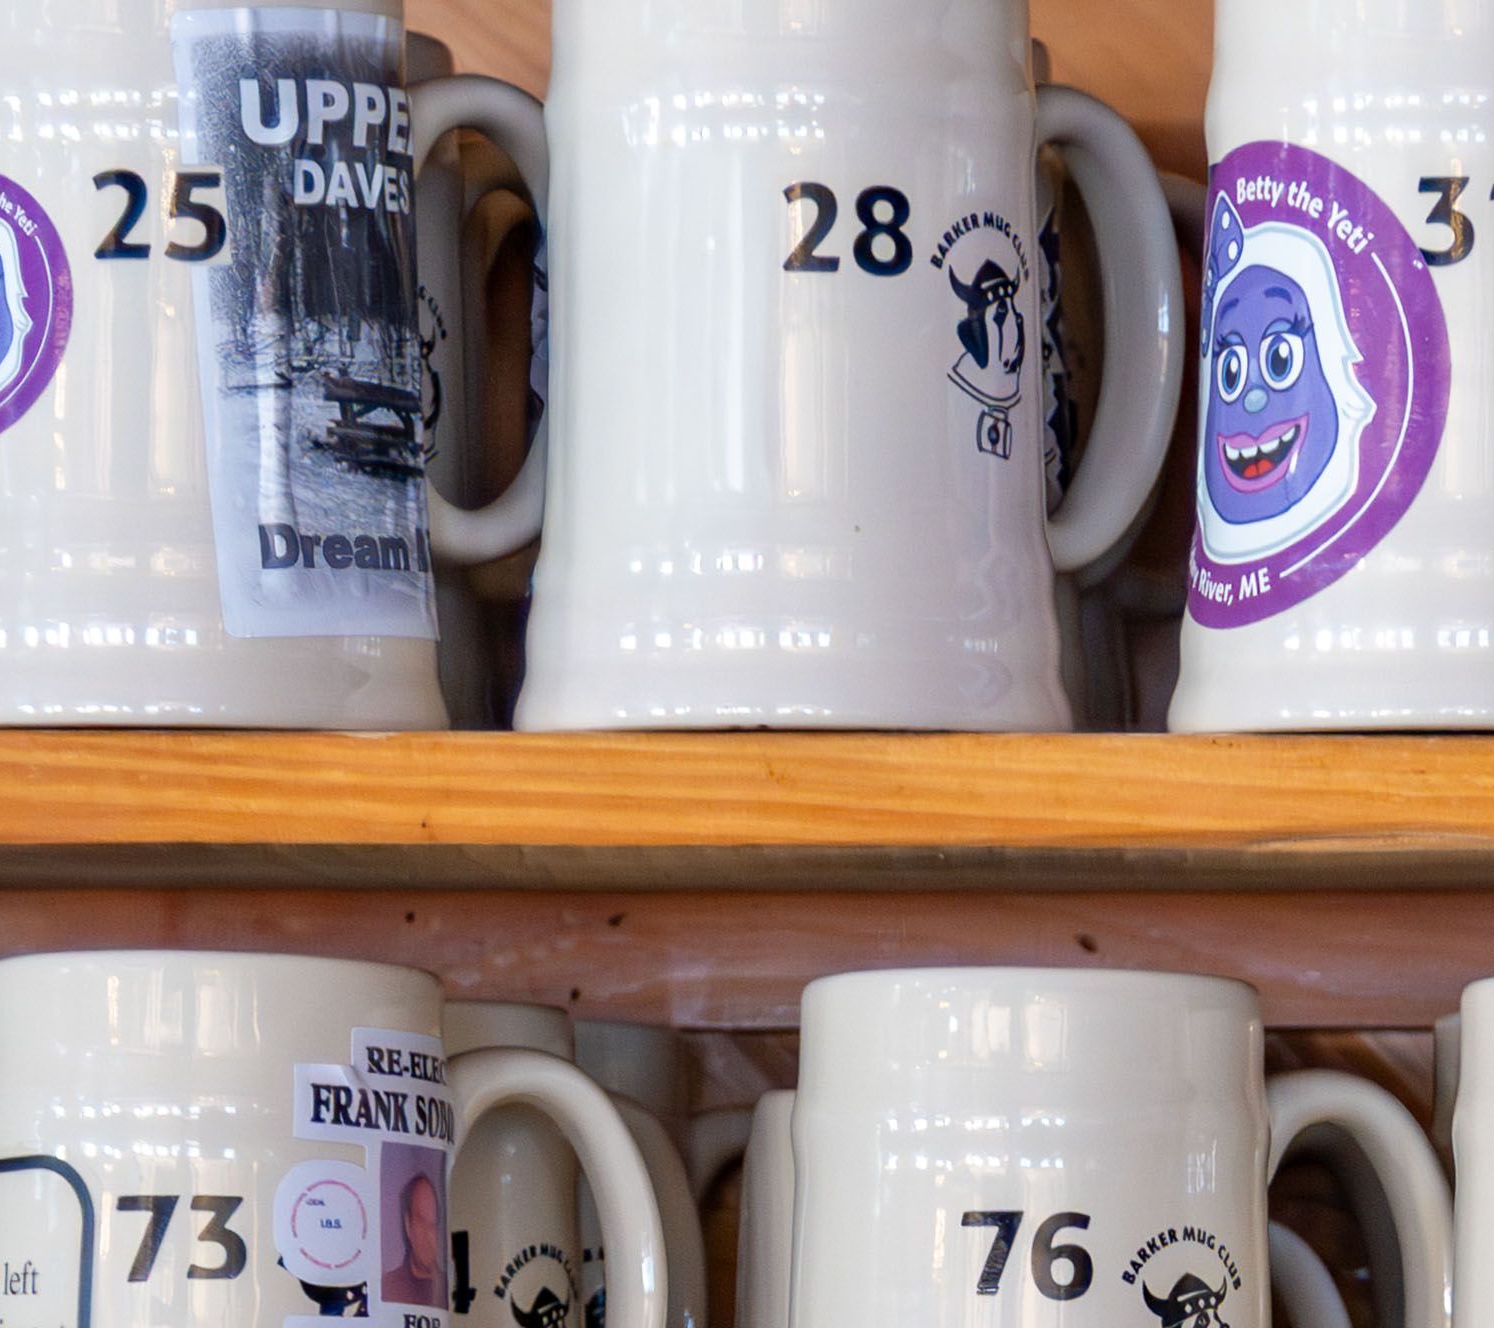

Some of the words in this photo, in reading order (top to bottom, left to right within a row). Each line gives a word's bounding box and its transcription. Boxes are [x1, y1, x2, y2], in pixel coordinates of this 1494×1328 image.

[13, 206, 37, 236] Yeti
[92, 168, 228, 262] 25
[782, 182, 913, 276] 28
[1237, 174, 1283, 206] Betty
[1287, 176, 1320, 218] the
[1327, 202, 1375, 254] Yeti
[1200, 568, 1234, 606] River,
[1238, 568, 1271, 601] ME
[310, 1083, 408, 1133] FRANK
[115, 1194, 248, 1283] 73
[961, 1210, 1094, 1302] 76
[1121, 1230, 1179, 1286] BARKER
[1181, 1225, 1217, 1252] MUG
[1217, 1244, 1241, 1291] CLUB
[5, 1261, 38, 1296] left
